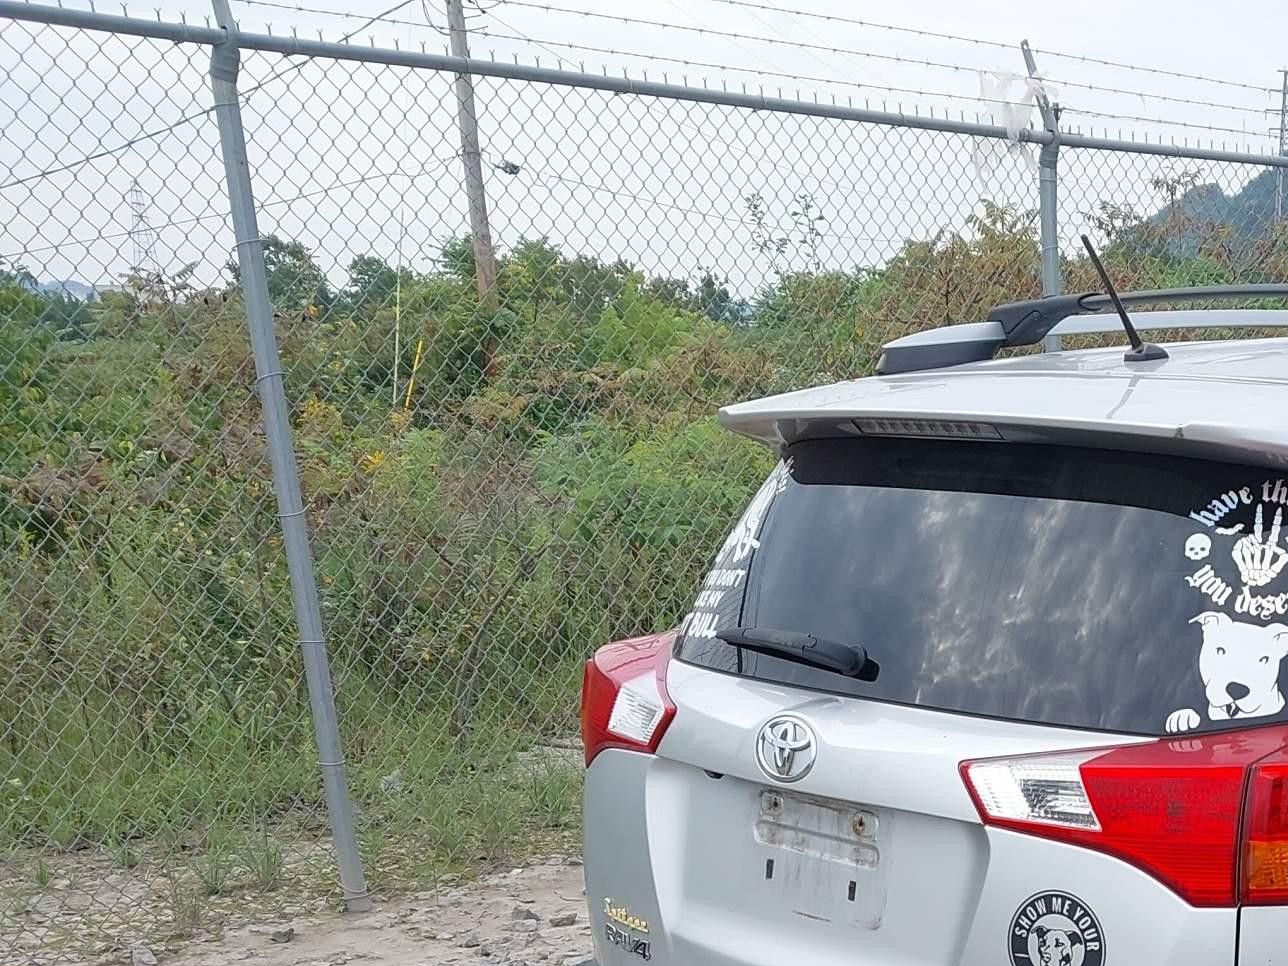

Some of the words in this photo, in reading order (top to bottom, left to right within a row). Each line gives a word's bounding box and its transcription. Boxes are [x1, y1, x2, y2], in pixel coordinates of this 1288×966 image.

[1189, 486, 1253, 527] have
[1184, 564, 1233, 606] you
[1014, 898, 1047, 938] SHOW
[1052, 896, 1072, 915] ME
[1073, 906, 1100, 952] YOUR
